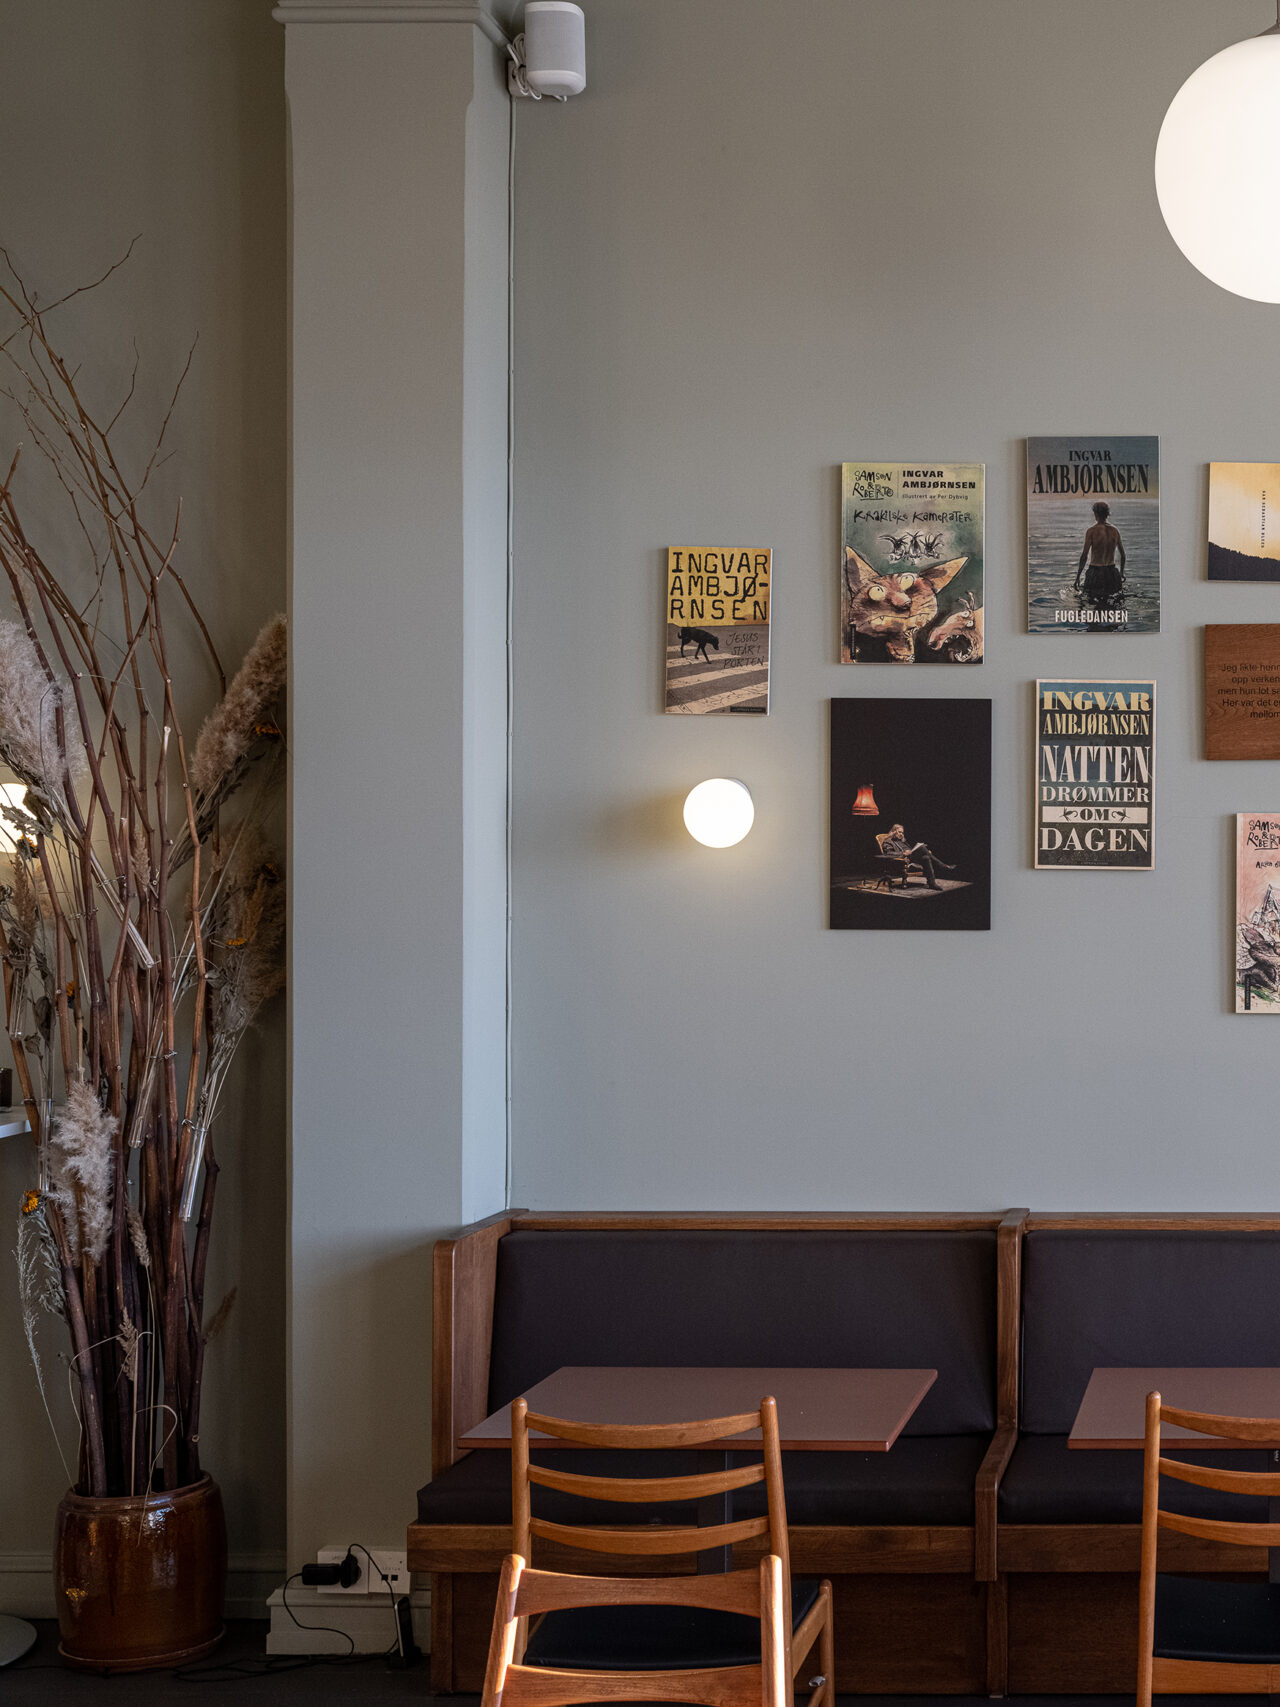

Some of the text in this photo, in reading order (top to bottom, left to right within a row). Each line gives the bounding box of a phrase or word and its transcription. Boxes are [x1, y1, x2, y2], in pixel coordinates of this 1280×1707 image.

[1068, 450, 1112, 461] INGVAR
[902, 470, 944, 478] INGVAR
[902, 481, 977, 489] AMBJØRNSEN
[1032, 461, 1150, 496] AMBJØRNSEN
[671, 551, 768, 575] INGVAR
[669, 572, 769, 603] AMBJØ-
[670, 598, 767, 621] RNSEN
[1054, 610, 1128, 623] FUGLEDANSEN
[1222, 663, 1238, 673] Jeg
[1042, 690, 1152, 712] INGVAR
[1042, 713, 1150, 736] AMBJØRNSEN
[1040, 745, 1152, 783] NATTEN
[1042, 786, 1150, 803] DRØMMER
[1079, 808, 1110, 821] OM
[1039, 827, 1151, 852] DAGEN
